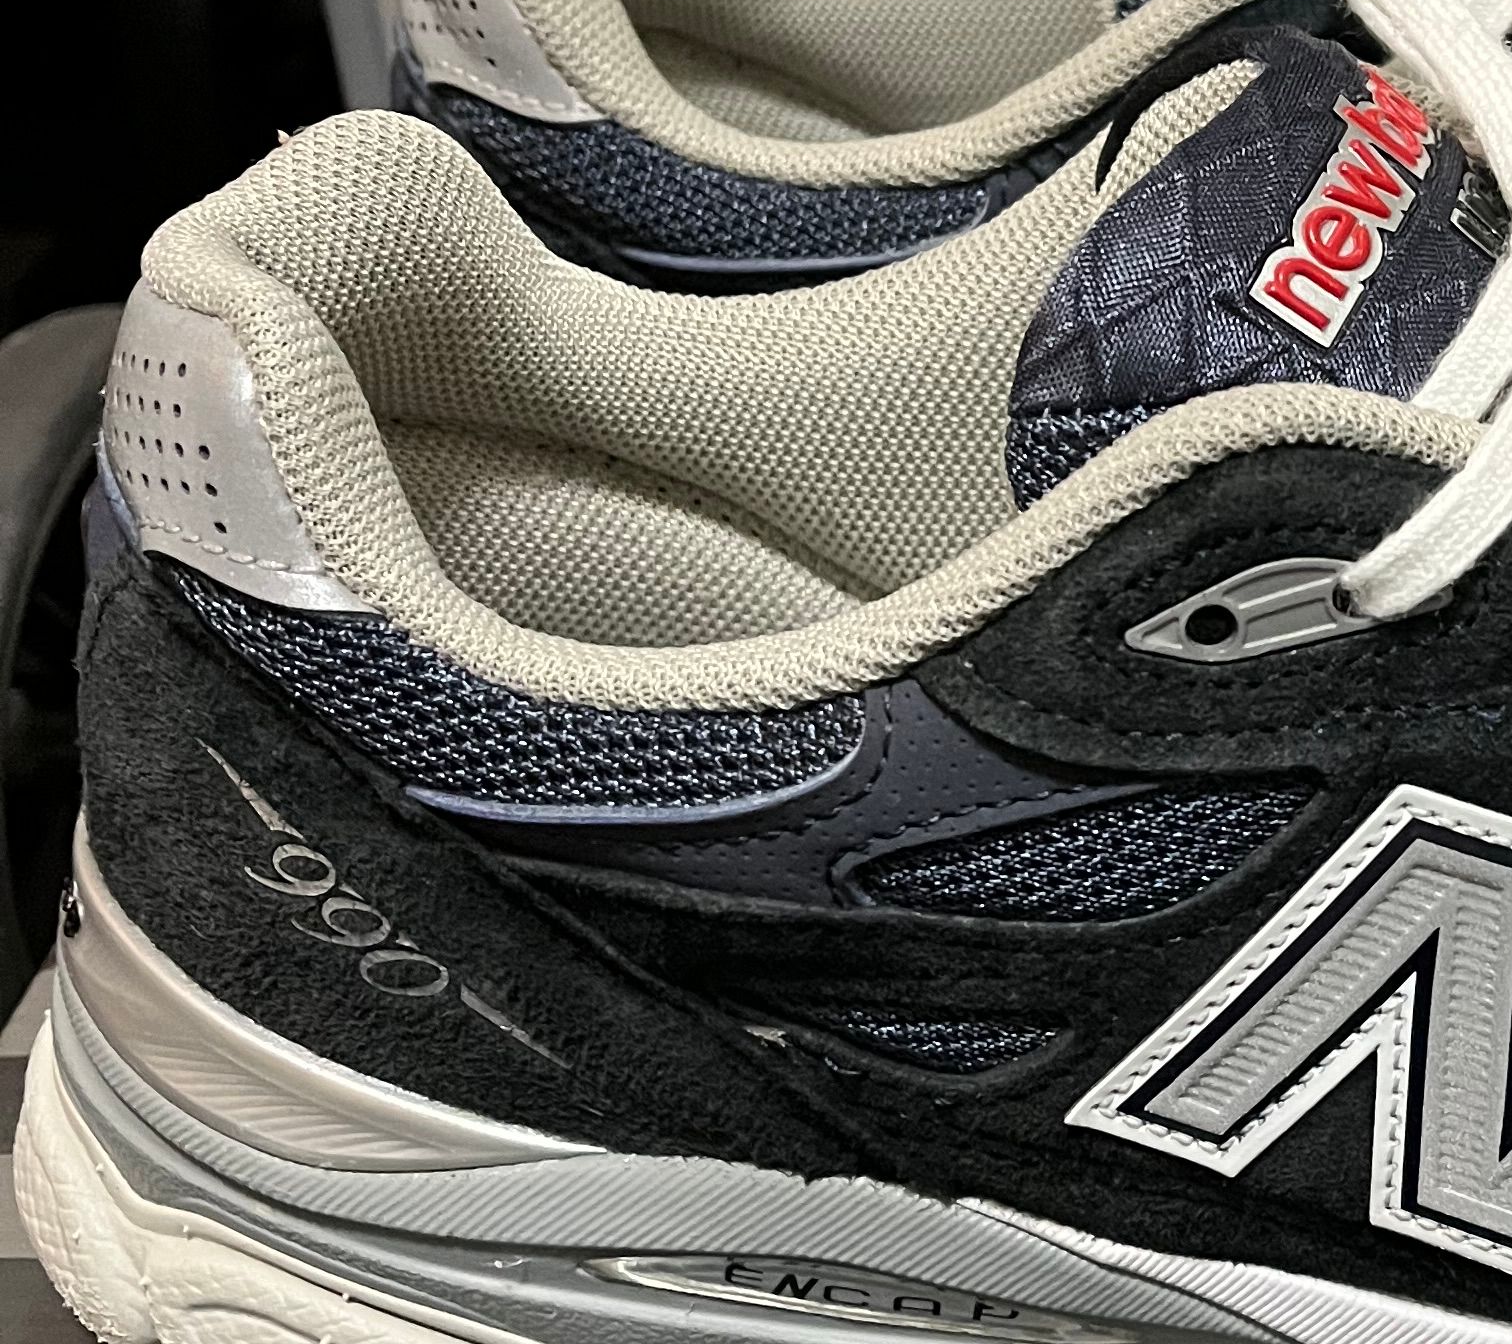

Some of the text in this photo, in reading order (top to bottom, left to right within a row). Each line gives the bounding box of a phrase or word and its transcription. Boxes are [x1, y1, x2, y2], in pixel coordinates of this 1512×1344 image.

[1262, 138, 1404, 333] new
[242, 842, 450, 998] 990
[724, 1260, 1020, 1323] ENCAP
